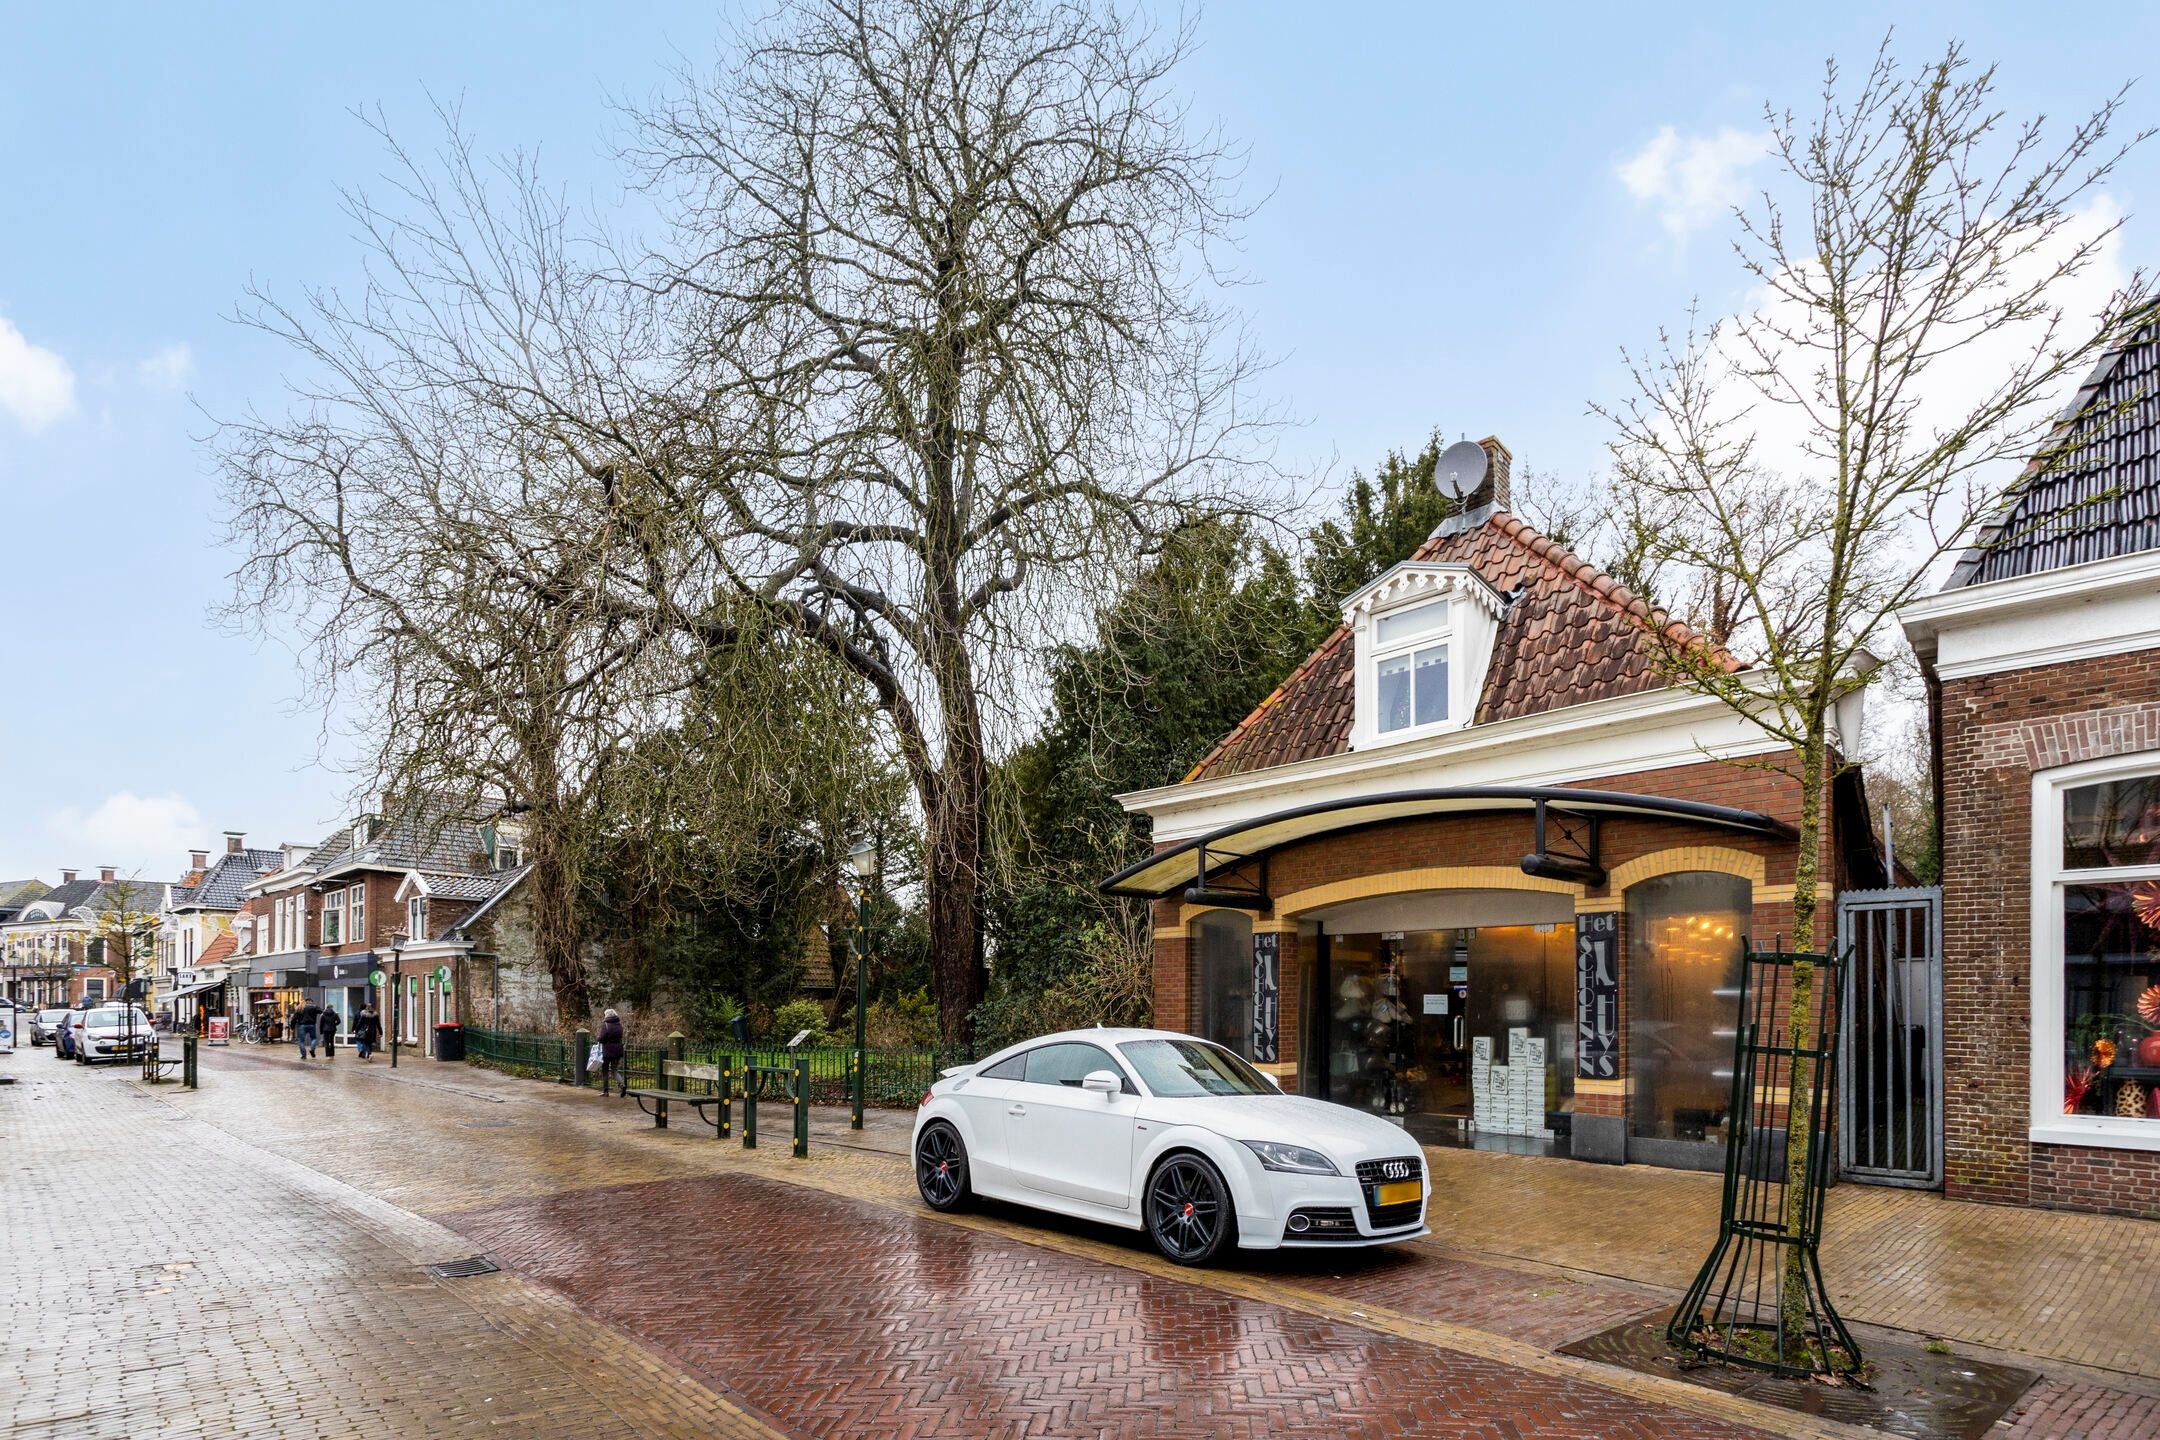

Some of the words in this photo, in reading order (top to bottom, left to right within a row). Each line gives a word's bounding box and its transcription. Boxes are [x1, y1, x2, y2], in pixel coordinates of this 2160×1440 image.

[1254, 933, 1278, 948] Het
[1579, 914, 1615, 933] Het
[1254, 950, 1265, 1061] SCHOENEN
[1265, 996, 1278, 1062] HUYS
[1578, 935, 1595, 1076] SCHOENEN
[1597, 994, 1616, 1077] HUYS
